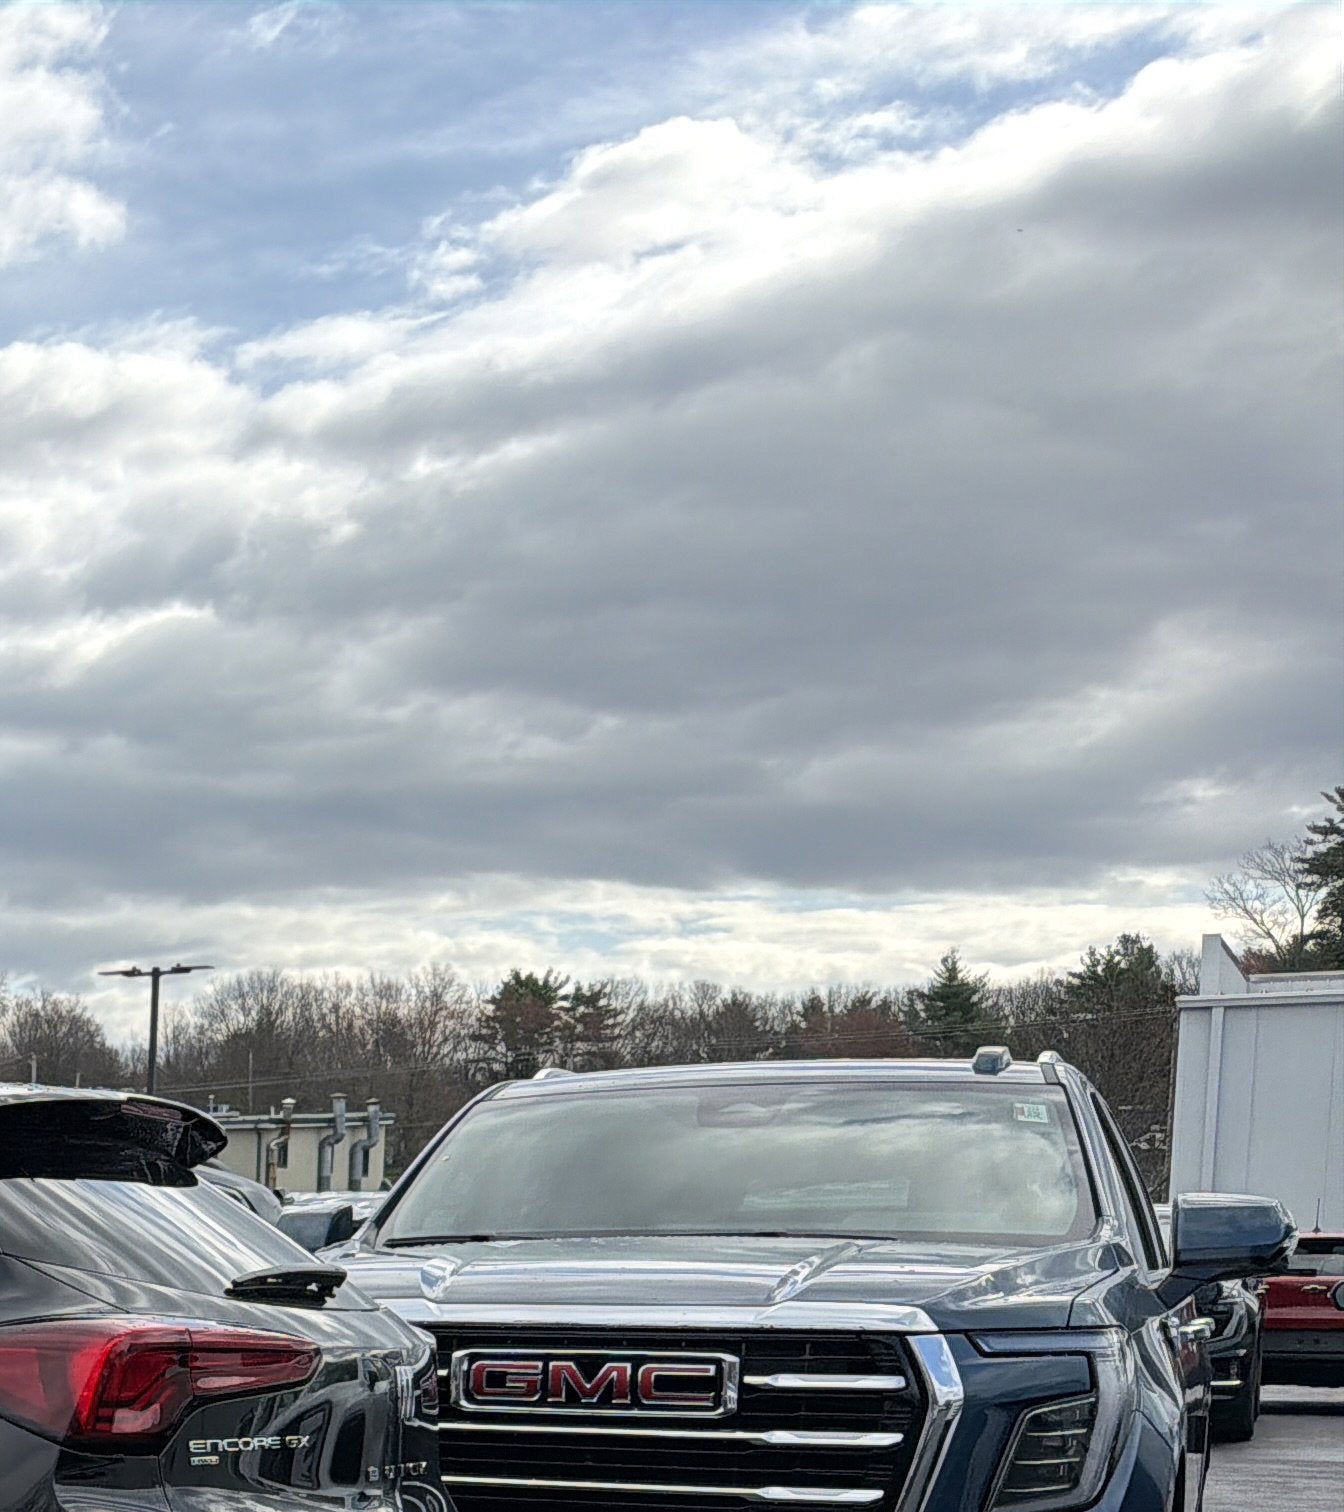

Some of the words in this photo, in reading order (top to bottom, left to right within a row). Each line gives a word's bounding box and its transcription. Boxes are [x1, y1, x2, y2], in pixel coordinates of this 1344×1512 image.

[470, 1360, 717, 1407] GMC
[189, 1436, 281, 1453] ENCORE
[285, 1434, 310, 1448] GX
